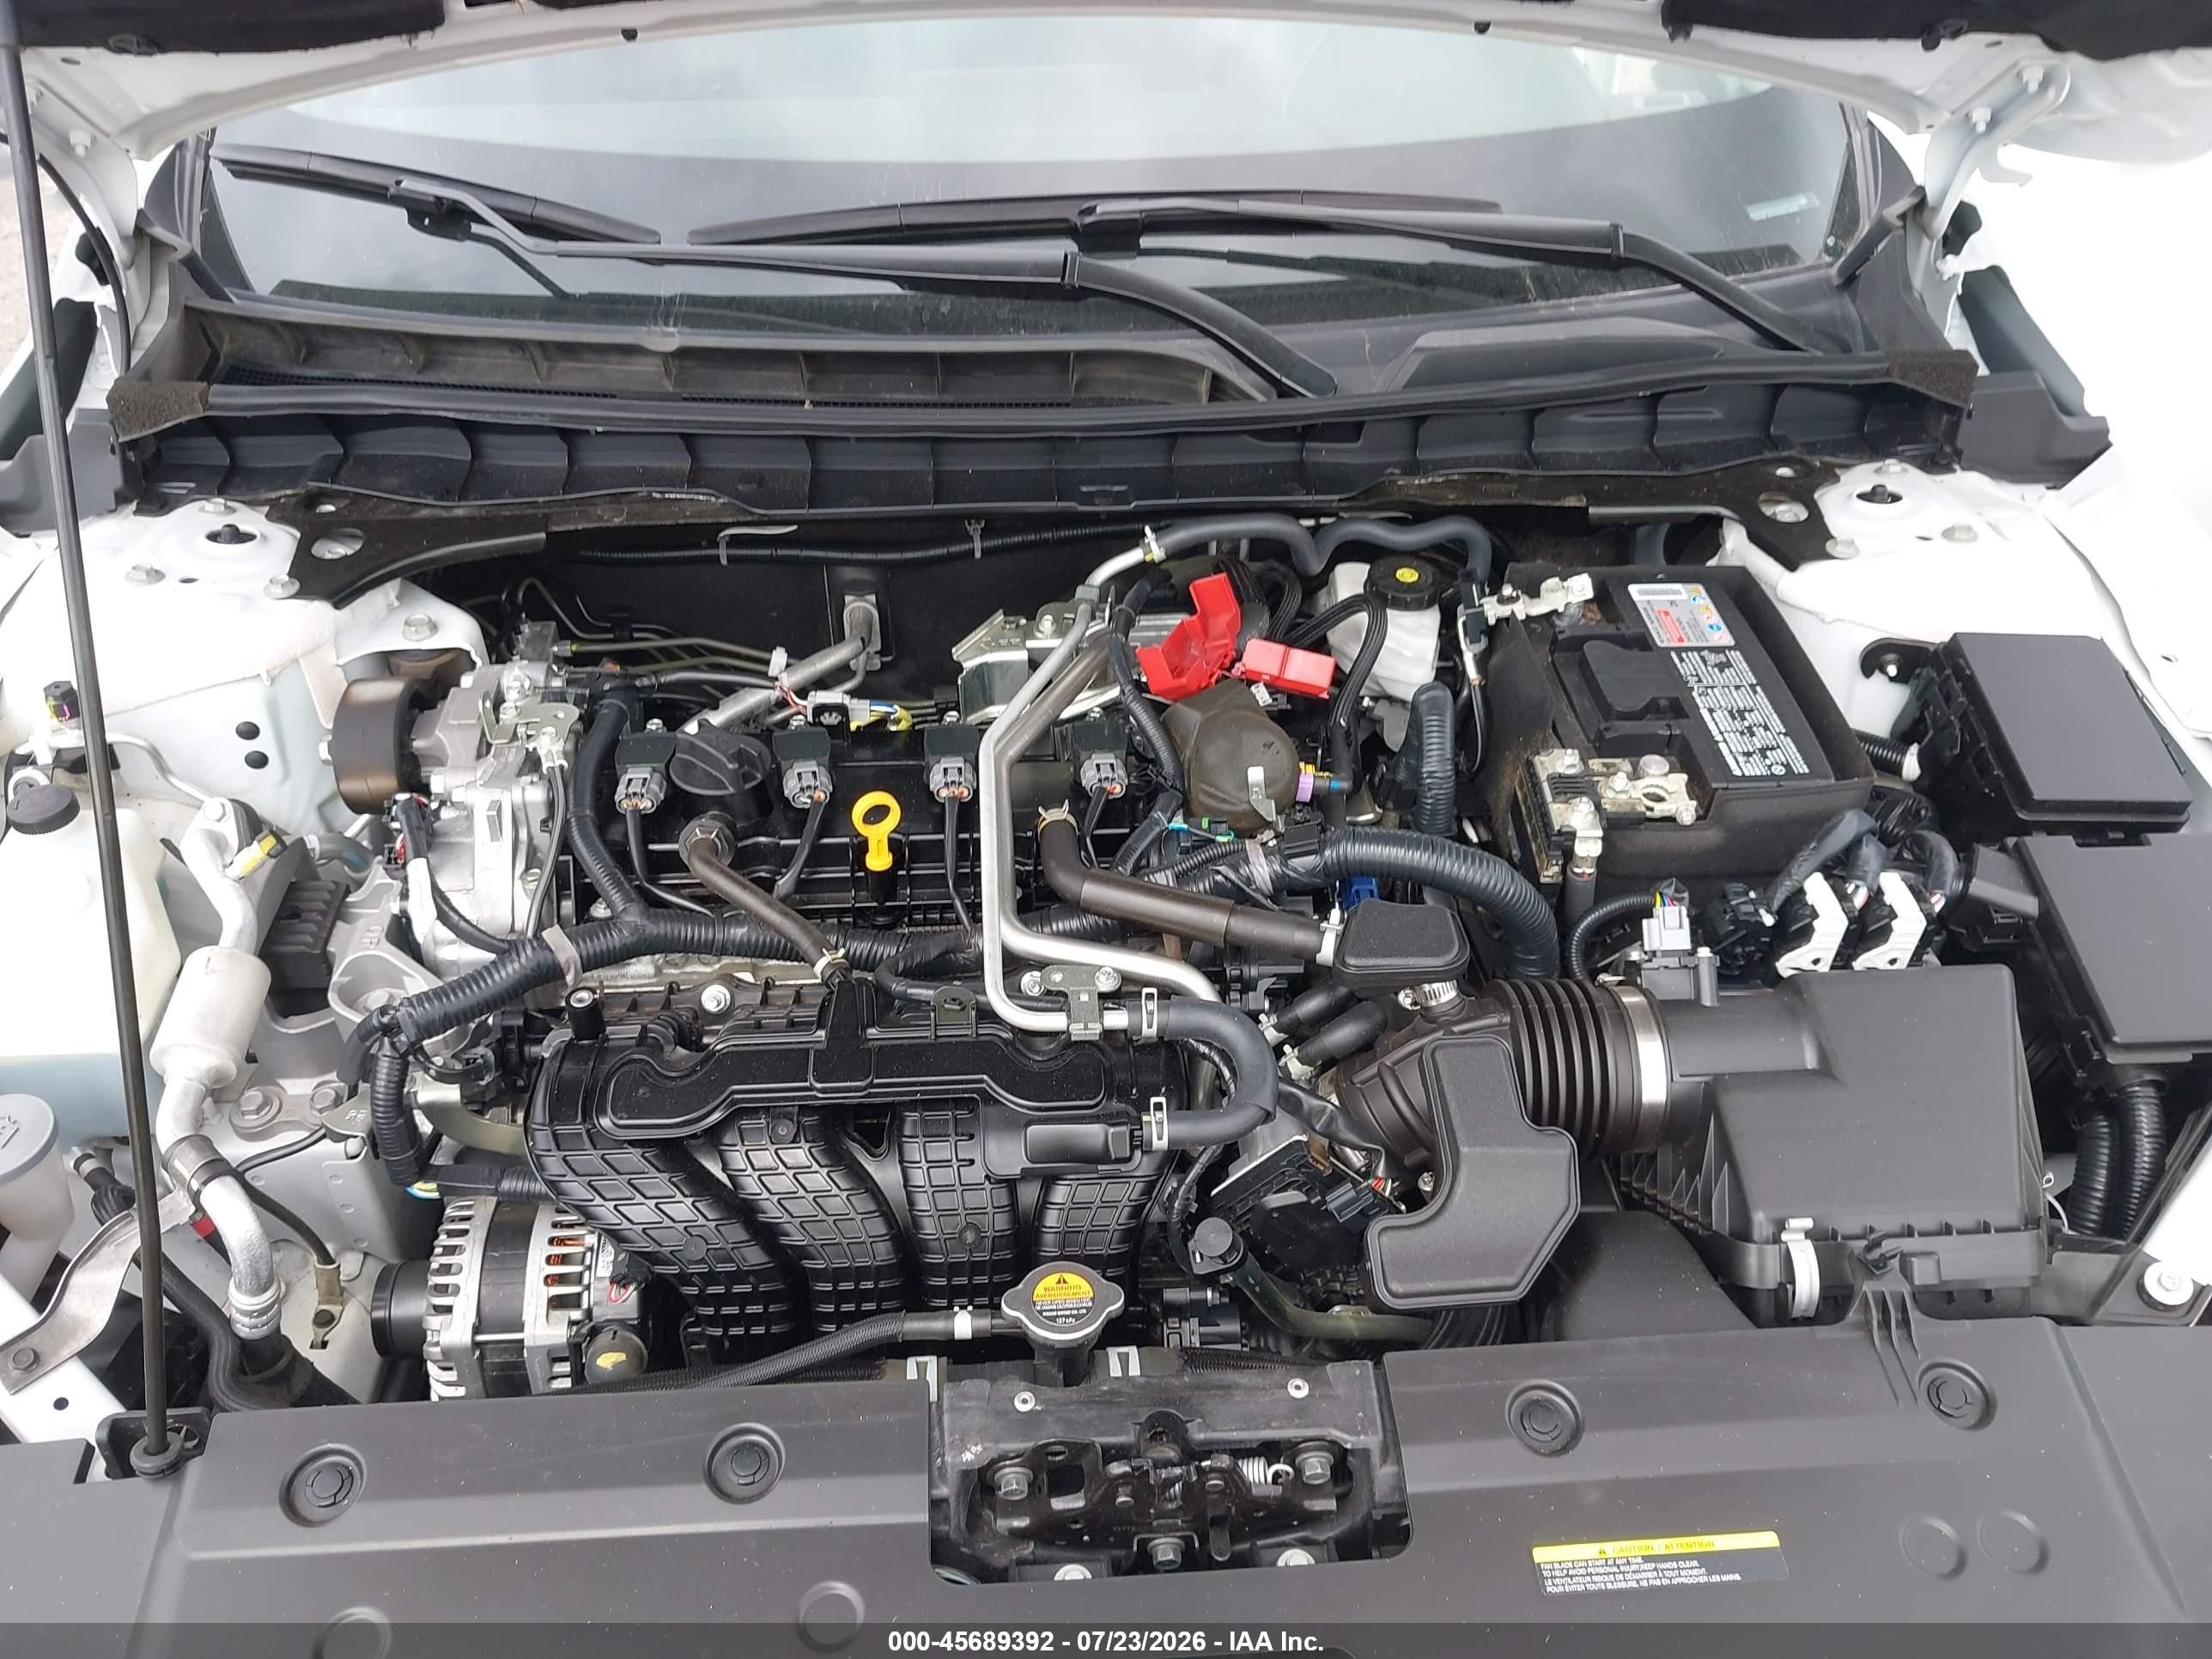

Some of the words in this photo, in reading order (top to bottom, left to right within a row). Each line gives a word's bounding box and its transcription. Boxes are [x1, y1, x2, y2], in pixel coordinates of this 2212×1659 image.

[1612, 1544, 1654, 1554] CAUTION
[1664, 1540, 1715, 1552] ATTENTION
[1569, 1567, 1587, 1576] AVOID
[1663, 1569, 1680, 1577] TOUT
[1546, 1584, 1565, 1594] POUR
